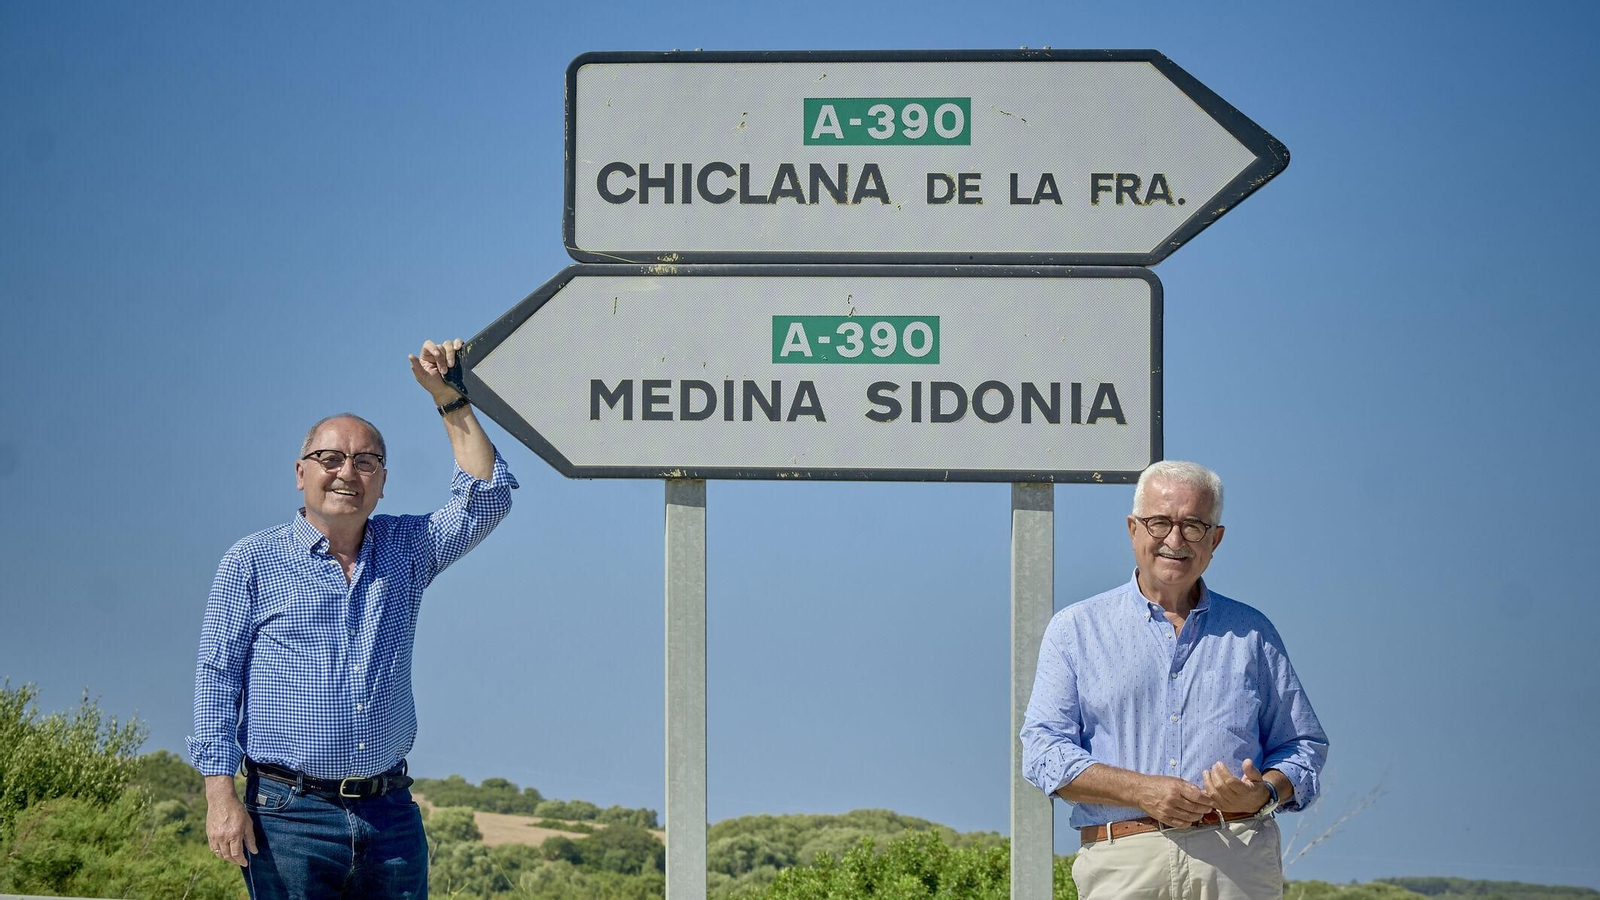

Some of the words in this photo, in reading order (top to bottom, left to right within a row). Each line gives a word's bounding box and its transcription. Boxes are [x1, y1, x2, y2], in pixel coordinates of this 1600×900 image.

[811, 102, 966, 140] A-390
[596, 162, 891, 205] CHICLANA
[926, 173, 983, 205] DE
[1009, 173, 1063, 205] LA
[1090, 173, 1187, 206] FRA.
[779, 320, 935, 359] A-390
[589, 379, 827, 423] MEDINA
[865, 380, 1127, 425] SIDONIA
